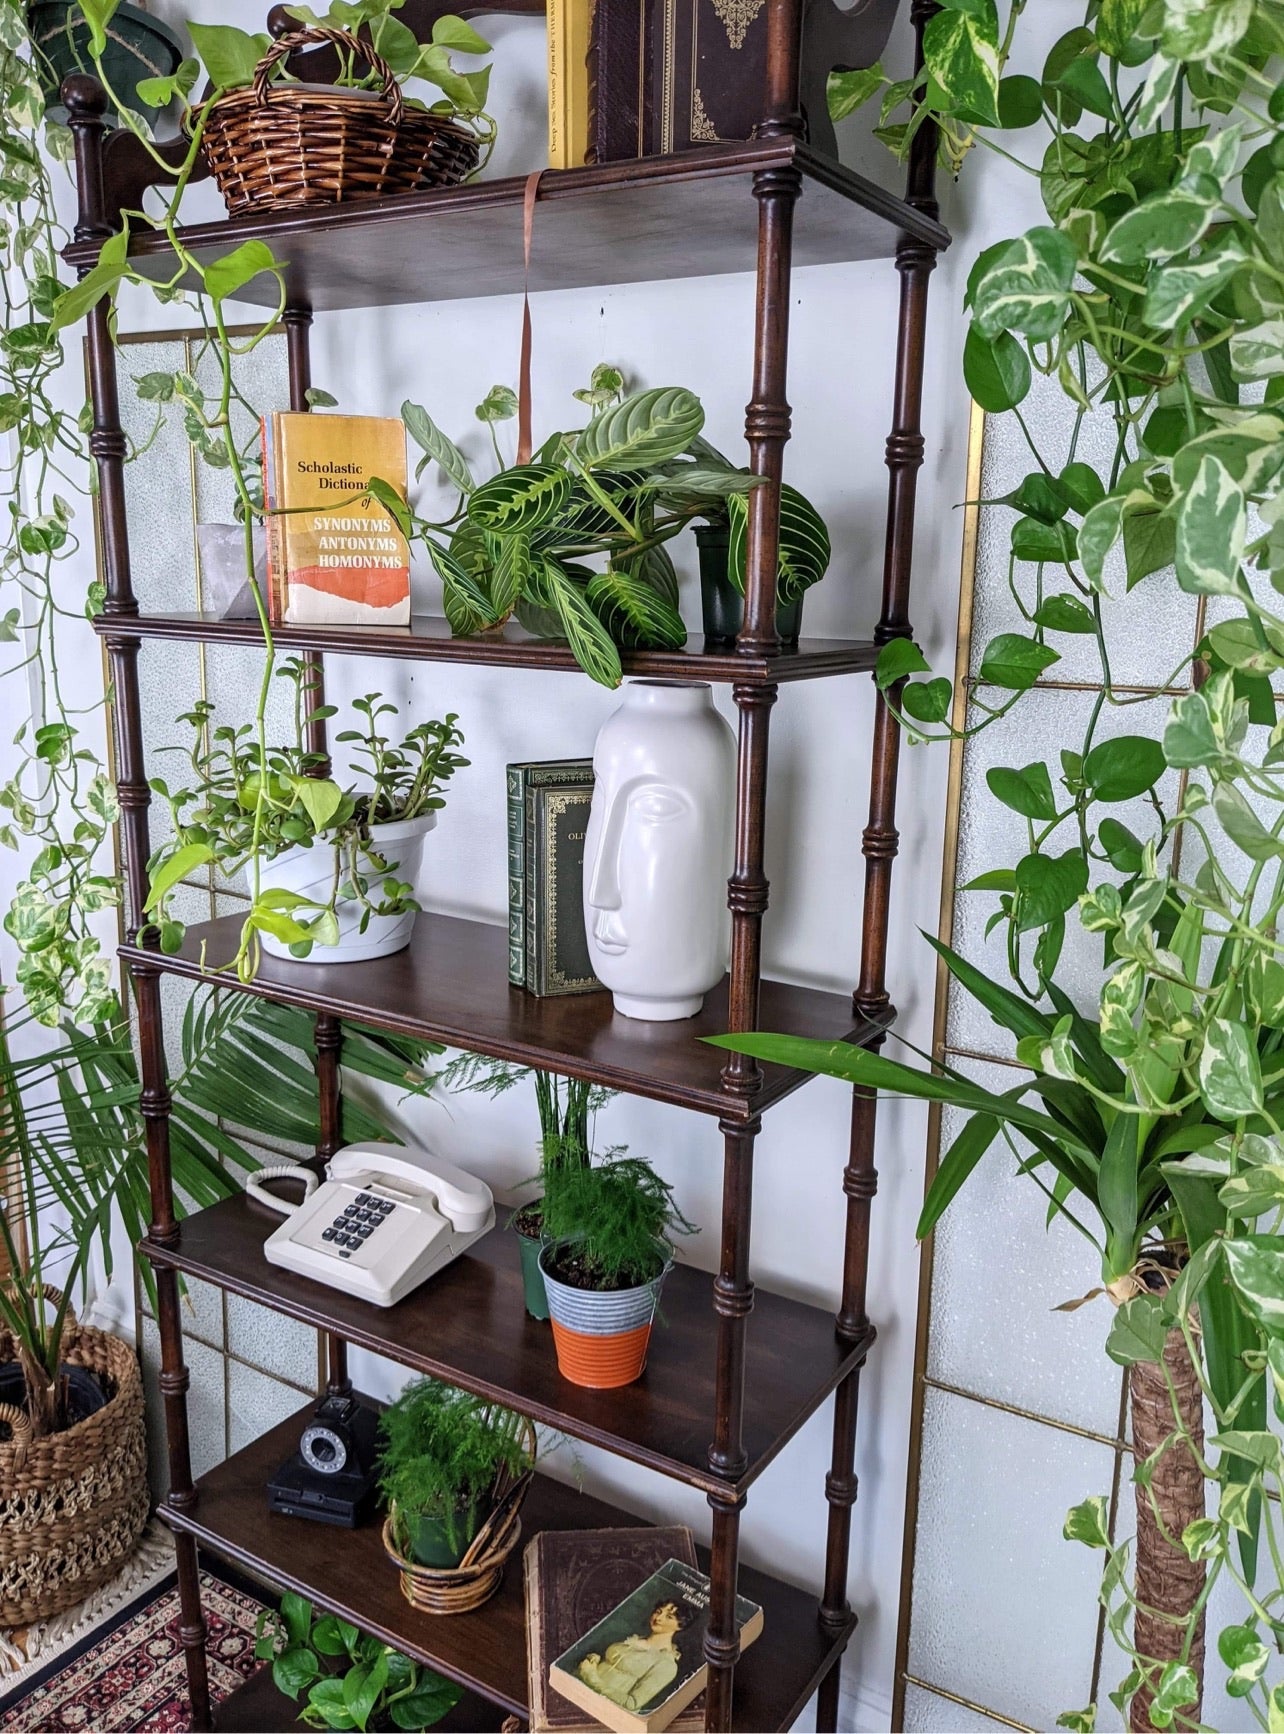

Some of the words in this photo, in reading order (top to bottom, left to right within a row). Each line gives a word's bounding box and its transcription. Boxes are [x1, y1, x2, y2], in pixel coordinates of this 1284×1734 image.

[298, 461, 363, 474] Scholastic
[361, 497, 371, 510] of
[314, 517, 391, 532] SYNONYMS
[319, 536, 397, 551] ANTONYMS
[319, 555, 402, 569] HOMONYMS
[676, 1581, 697, 1595] JANE
[682, 1593, 705, 1608] EMMA
